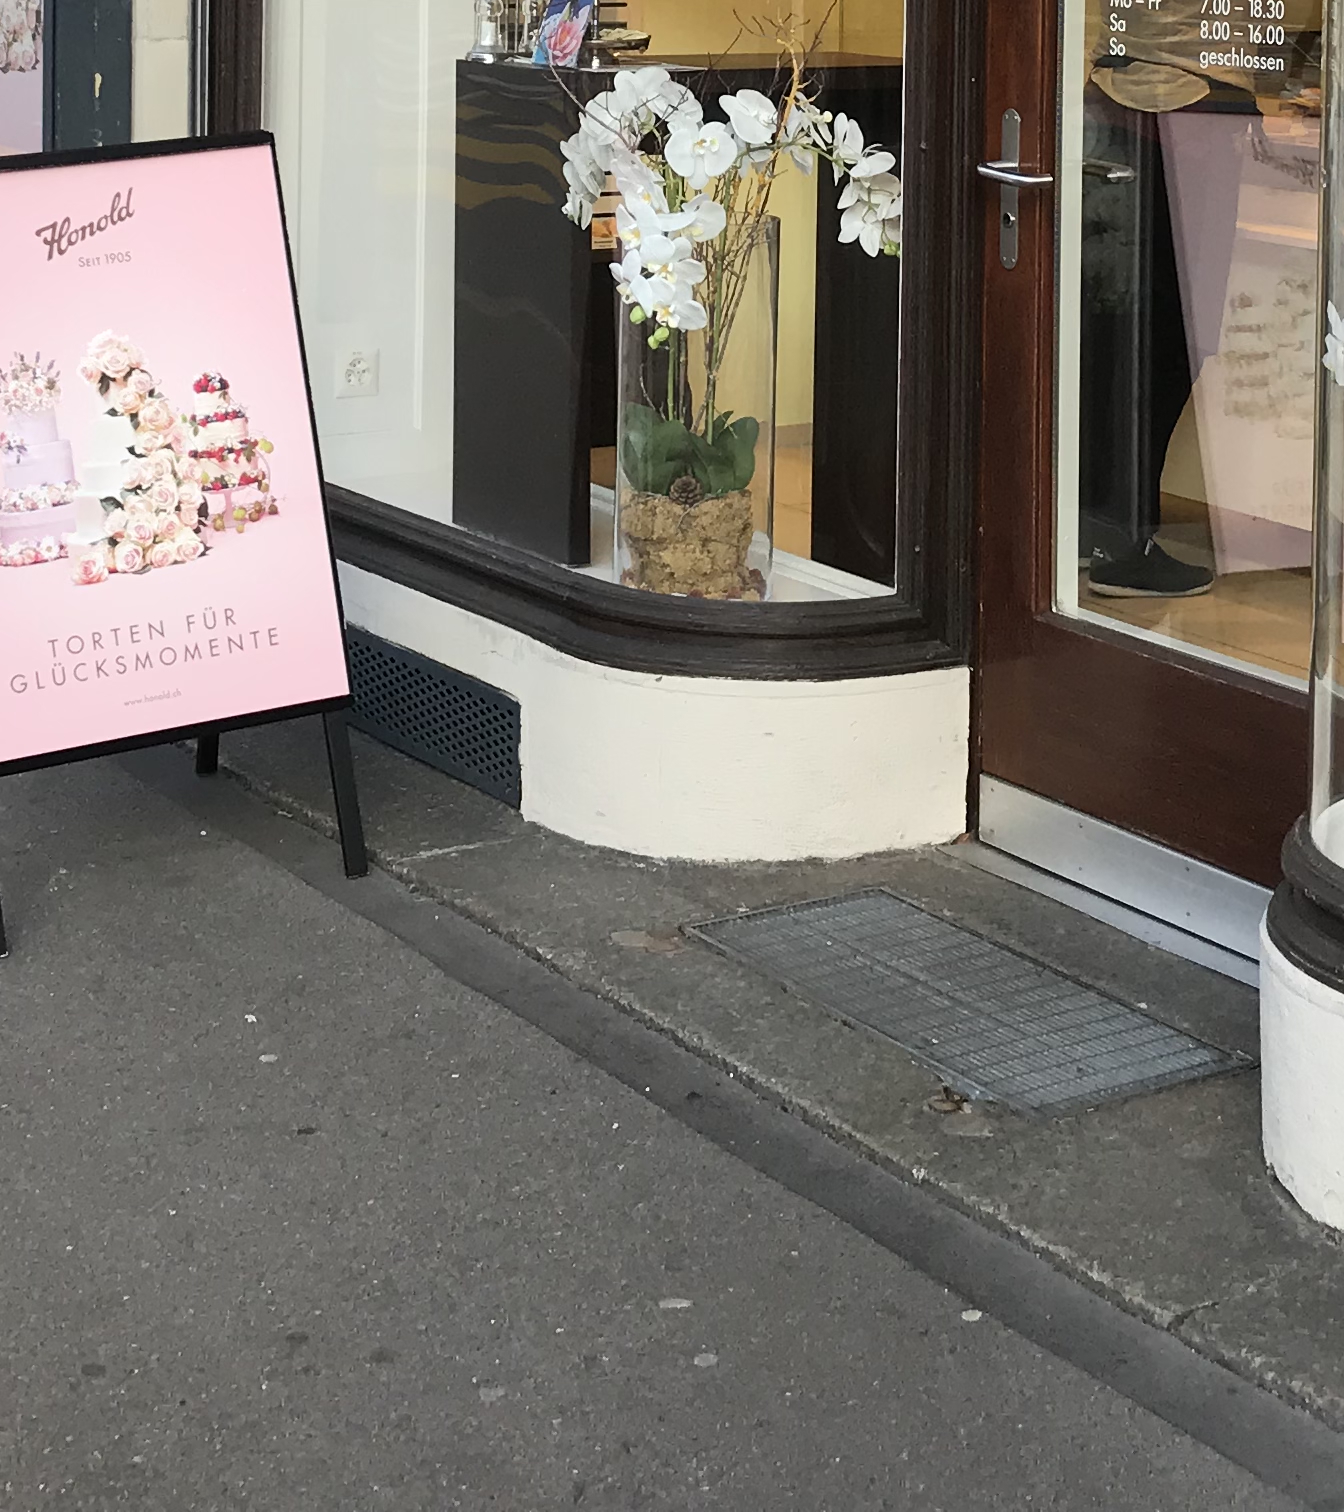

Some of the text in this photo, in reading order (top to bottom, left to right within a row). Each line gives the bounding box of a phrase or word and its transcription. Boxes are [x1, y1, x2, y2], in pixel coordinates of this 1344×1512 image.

[1109, 13, 1127, 32] Sa
[1200, 20, 1231, 41] 8.00
[1247, 24, 1285, 46] 16.00
[1109, 37, 1285, 72] So geschlossen
[35, 186, 136, 262] Honold
[104, 249, 133, 266] 1905
[47, 606, 239, 659] TORTEN FÜR
[9, 626, 281, 696] GLÜCKSMOMENTE
[123, 688, 183, 707] www.honold.ch
